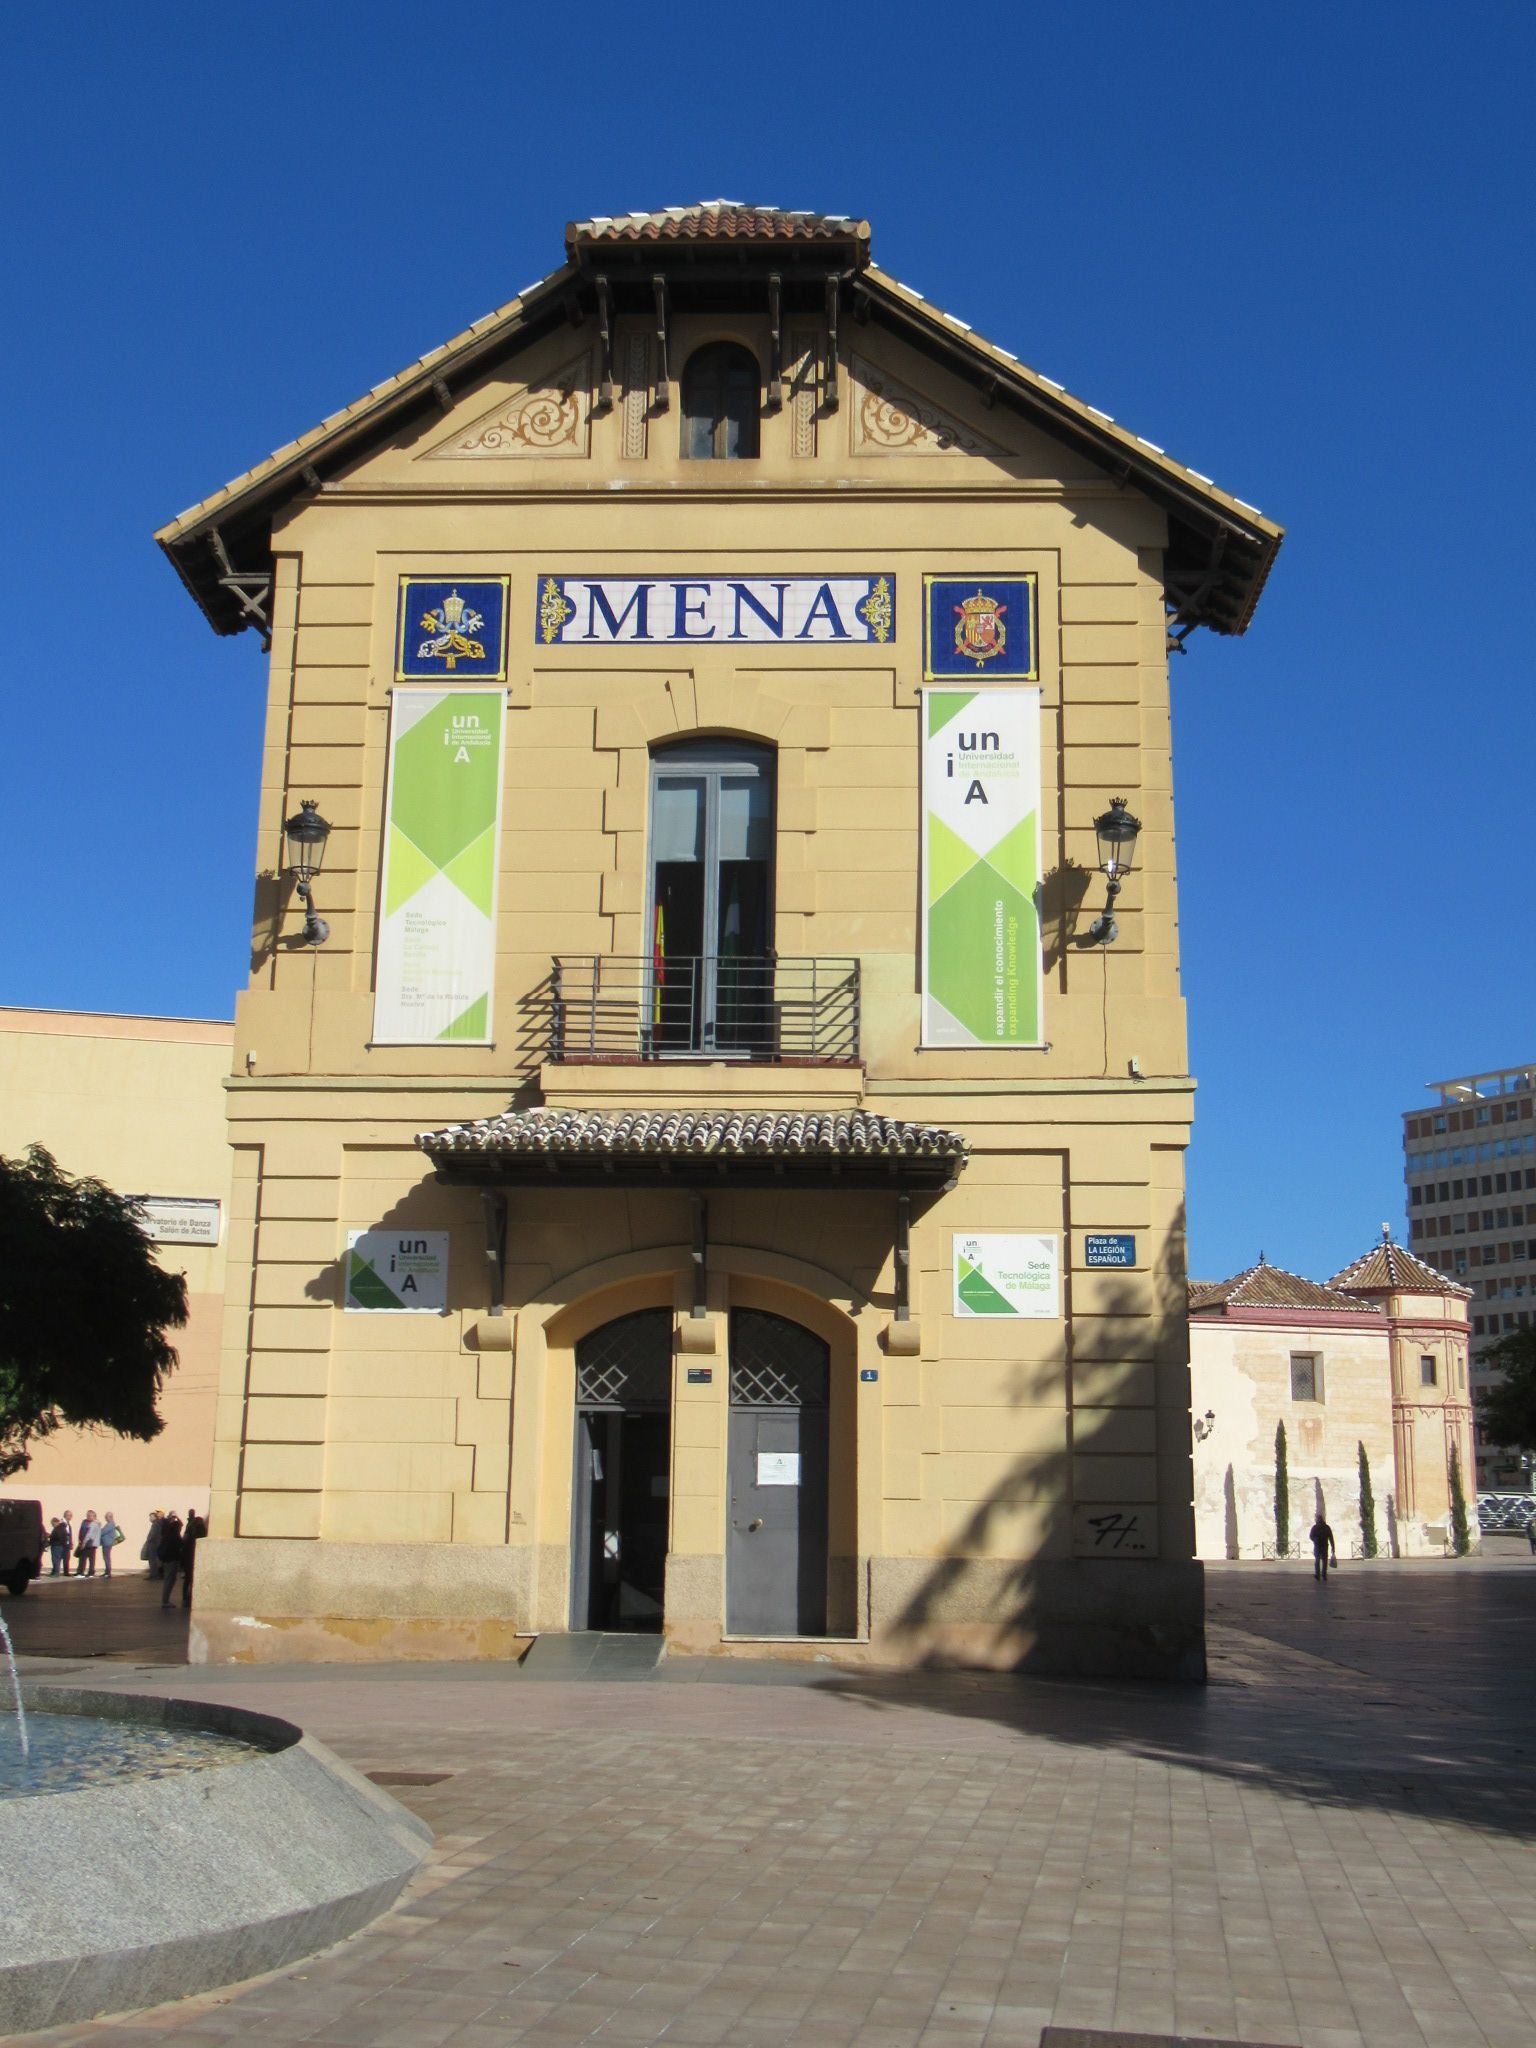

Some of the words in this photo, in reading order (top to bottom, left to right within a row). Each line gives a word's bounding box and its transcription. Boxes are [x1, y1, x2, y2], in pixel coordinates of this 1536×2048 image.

[582, 582, 852, 640] MENA
[452, 715, 480, 728] un
[444, 729, 450, 745] i
[959, 732, 999, 751] un
[454, 746, 471, 763] A
[959, 752, 1015, 761] Universidad
[947, 753, 954, 777] i
[964, 780, 989, 804] A
[994, 900, 1004, 973] conocimiento
[1007, 916, 1018, 976] Knowledge
[994, 975, 1004, 985] el
[994, 987, 1006, 1035] expandir
[1007, 978, 1018, 1035] expanding
[400, 1240, 427, 1253] un
[1088, 1237, 1107, 1245] Plaza
[1108, 1237, 1118, 1245] de
[1088, 1246, 1098, 1254] LA
[1099, 1244, 1126, 1254] LEGIÓN
[390, 1255, 396, 1272] i
[1027, 1261, 1050, 1270] Sede
[1088, 1254, 1127, 1263] ESPAÑOLA
[401, 1274, 418, 1292] A
[998, 1271, 1050, 1281] Tecnológica
